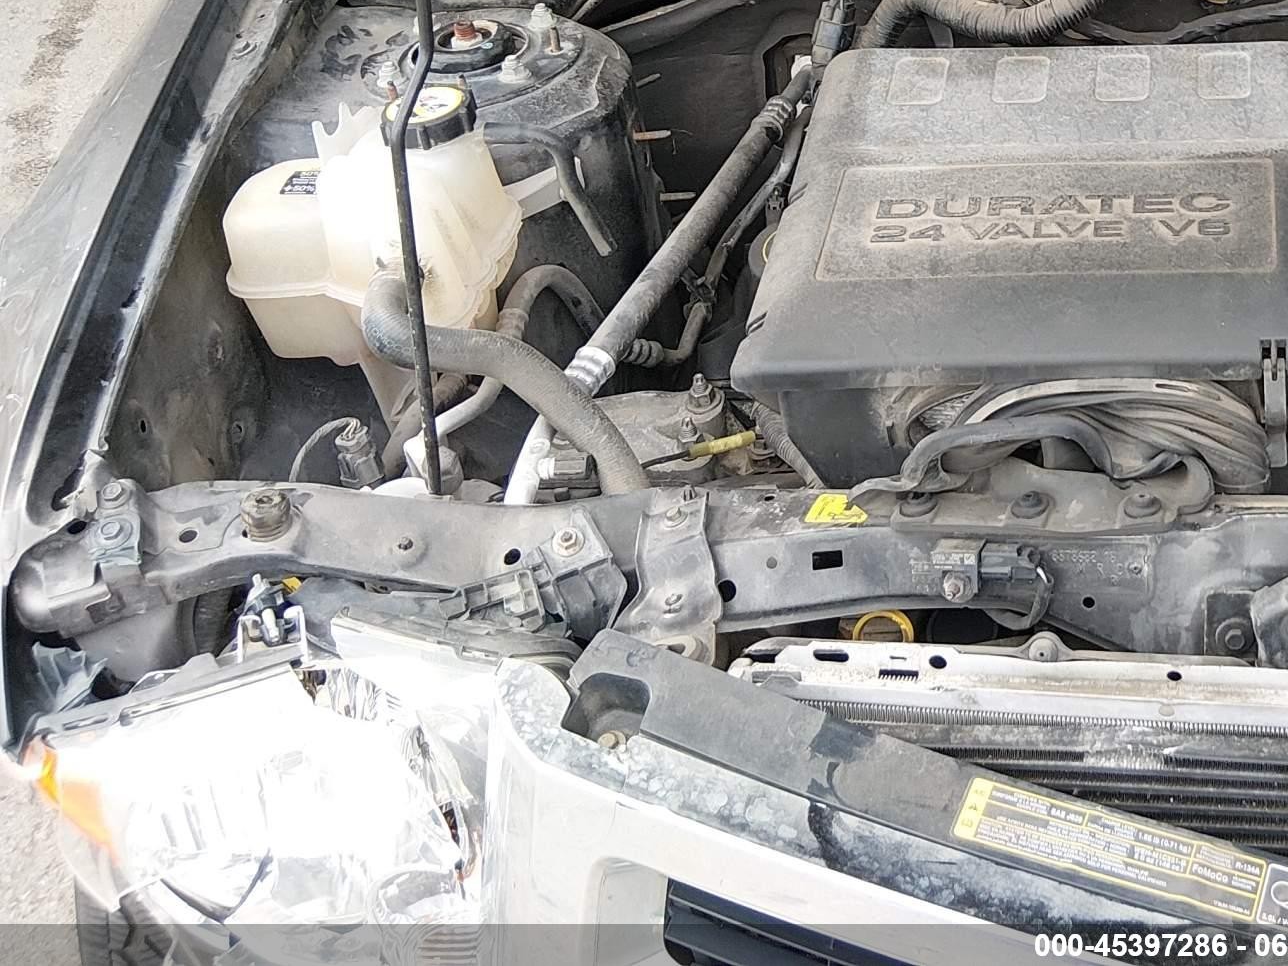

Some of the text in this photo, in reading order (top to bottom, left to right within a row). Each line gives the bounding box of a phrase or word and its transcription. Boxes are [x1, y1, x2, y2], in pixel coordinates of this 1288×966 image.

[875, 192, 1232, 219] DURATEC
[870, 218, 1232, 243] 24 VALVE V6
